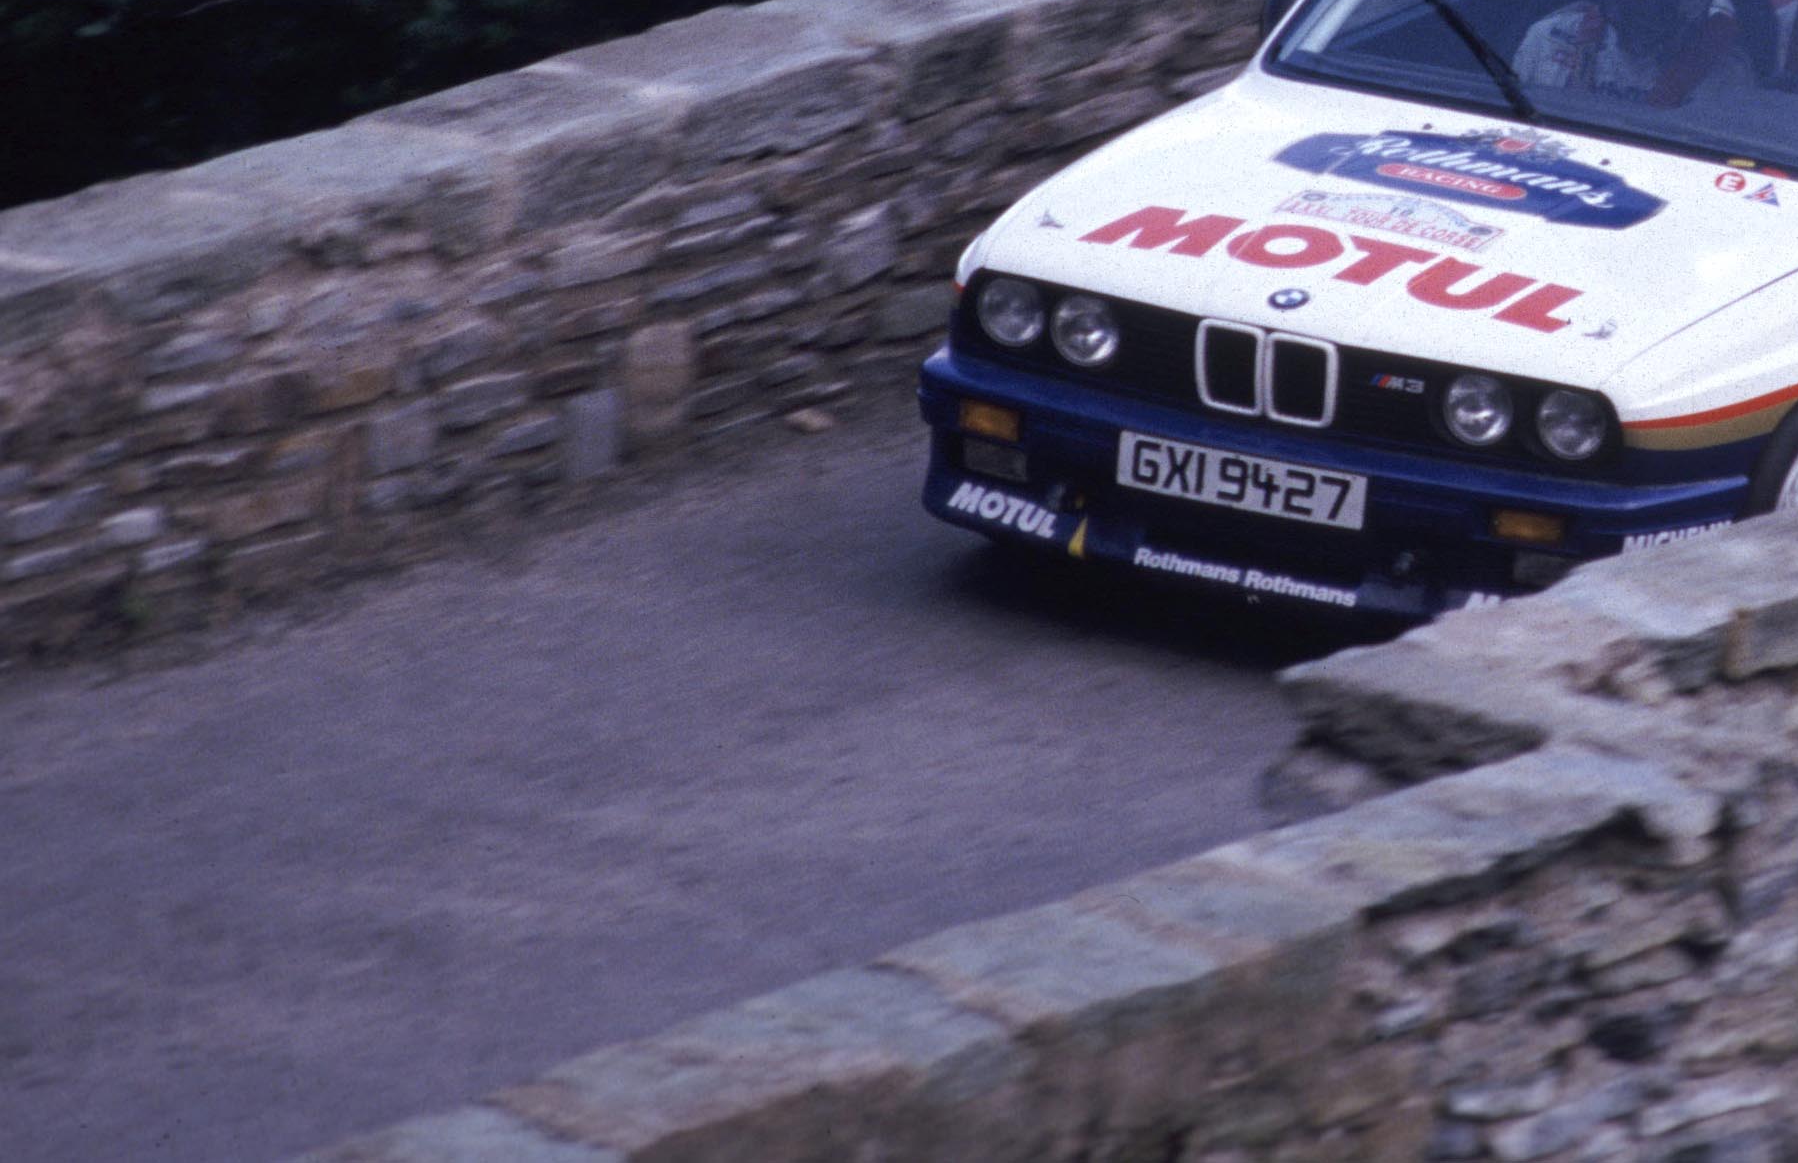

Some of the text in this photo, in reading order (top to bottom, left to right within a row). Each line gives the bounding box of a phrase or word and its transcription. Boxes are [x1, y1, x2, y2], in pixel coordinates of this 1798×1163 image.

[1338, 137, 1616, 208] Rothmans
[1400, 168, 1503, 194] RACING
[1078, 205, 1585, 333] MOTUL
[1385, 375, 1425, 394] M3
[947, 482, 1055, 539] MOTUL
[1132, 439, 1353, 521] GXI 9427
[1133, 547, 1357, 608] Rothmans Rothmans
